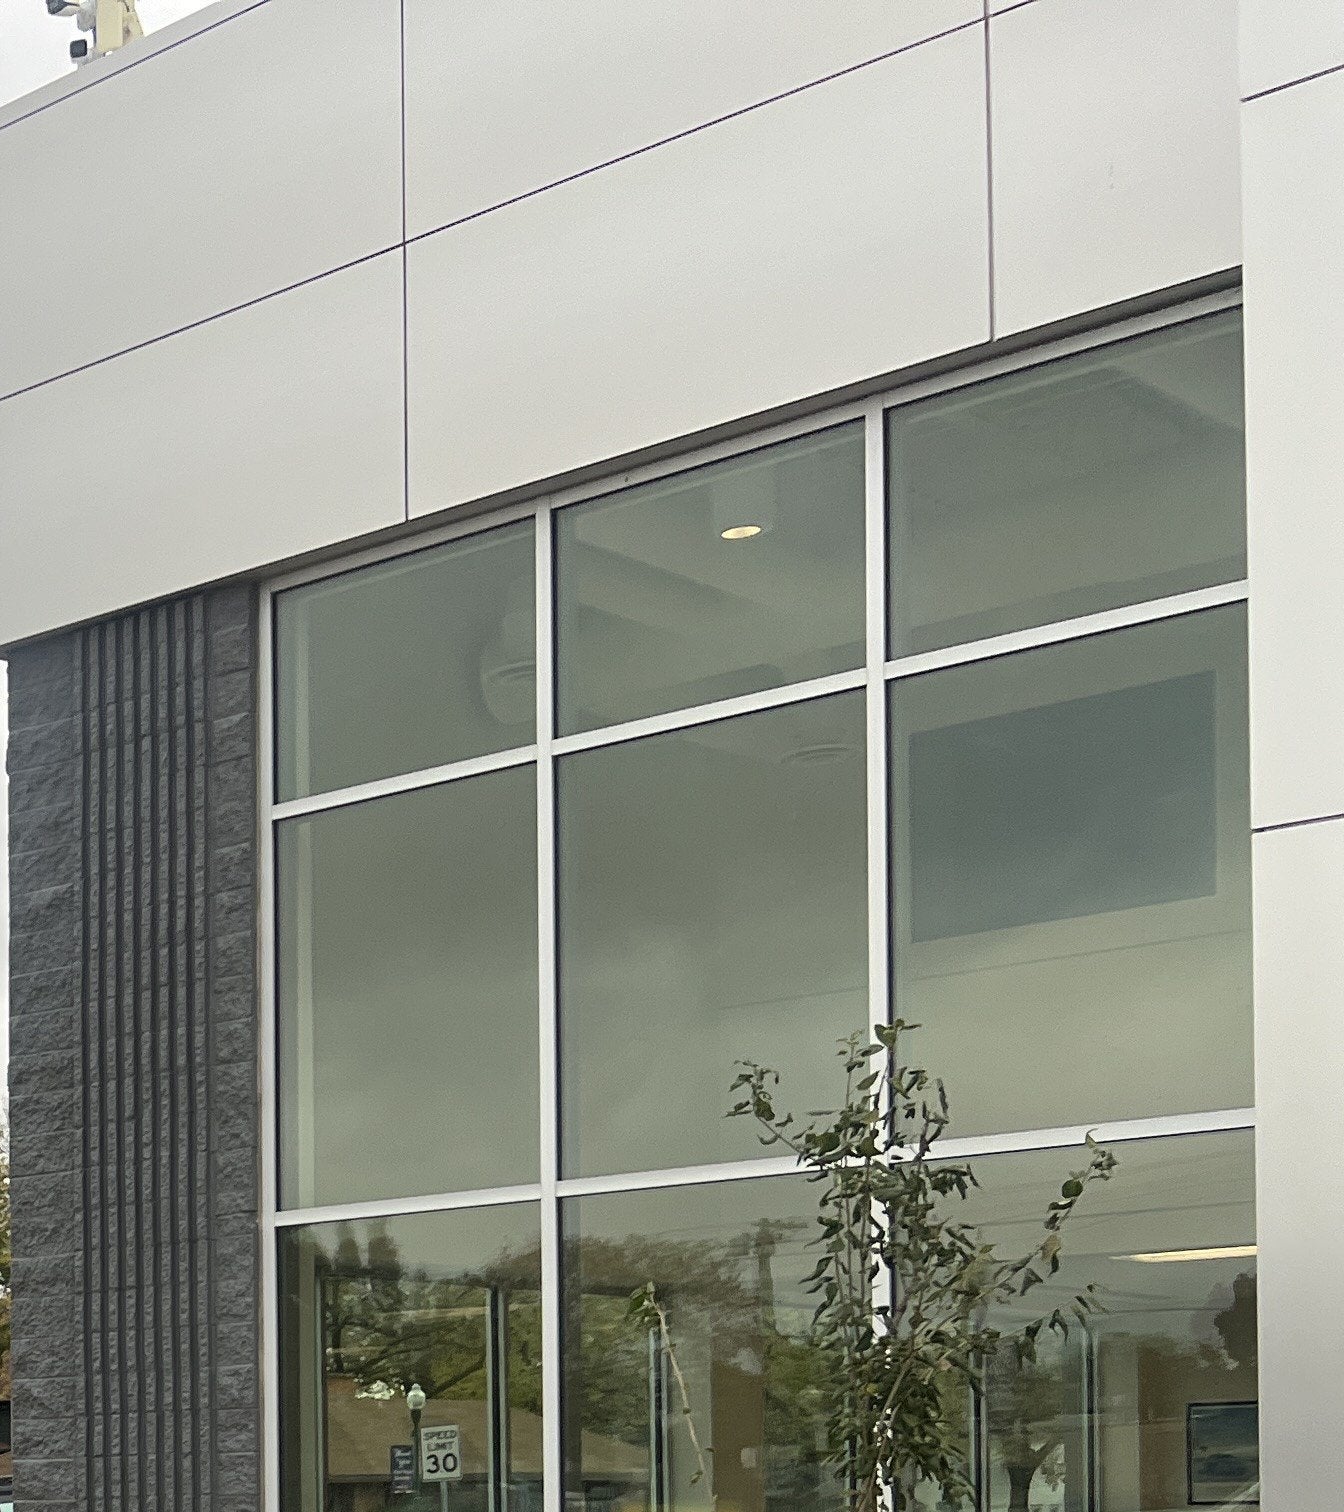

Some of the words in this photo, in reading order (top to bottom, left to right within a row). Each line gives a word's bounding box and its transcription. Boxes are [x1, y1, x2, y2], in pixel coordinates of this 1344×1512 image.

[423, 1429, 457, 1441] SPEED
[427, 1440, 455, 1451] LIMIT
[426, 1453, 458, 1473] 30
